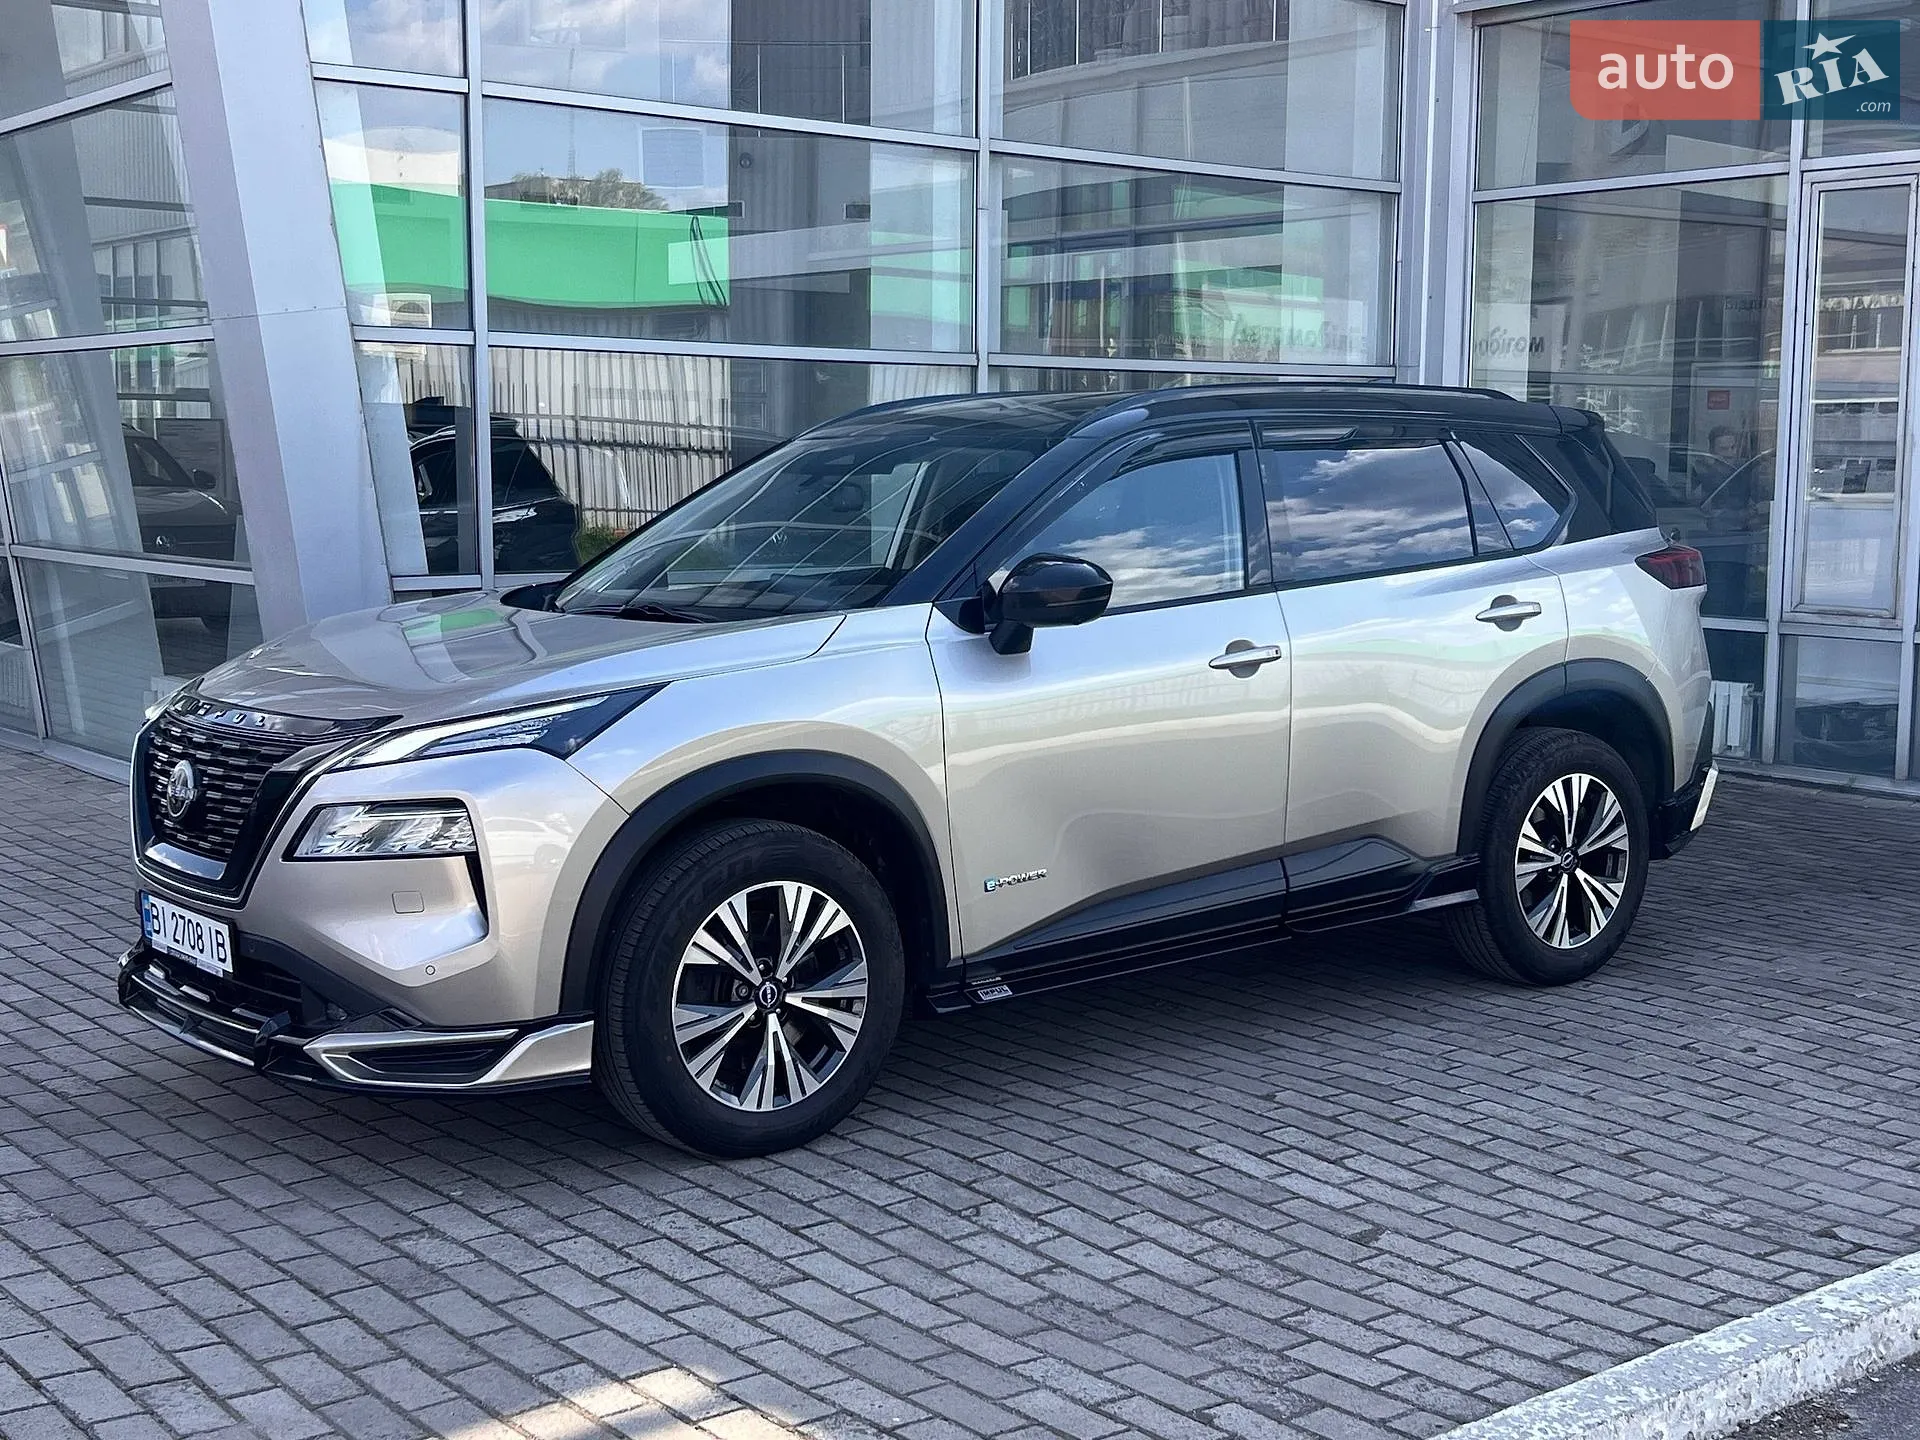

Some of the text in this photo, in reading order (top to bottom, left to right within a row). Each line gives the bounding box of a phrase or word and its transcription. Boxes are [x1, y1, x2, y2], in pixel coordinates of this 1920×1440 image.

[150, 902, 167, 938] BI
[171, 911, 205, 954] 2708
[208, 926, 227, 964] IB
